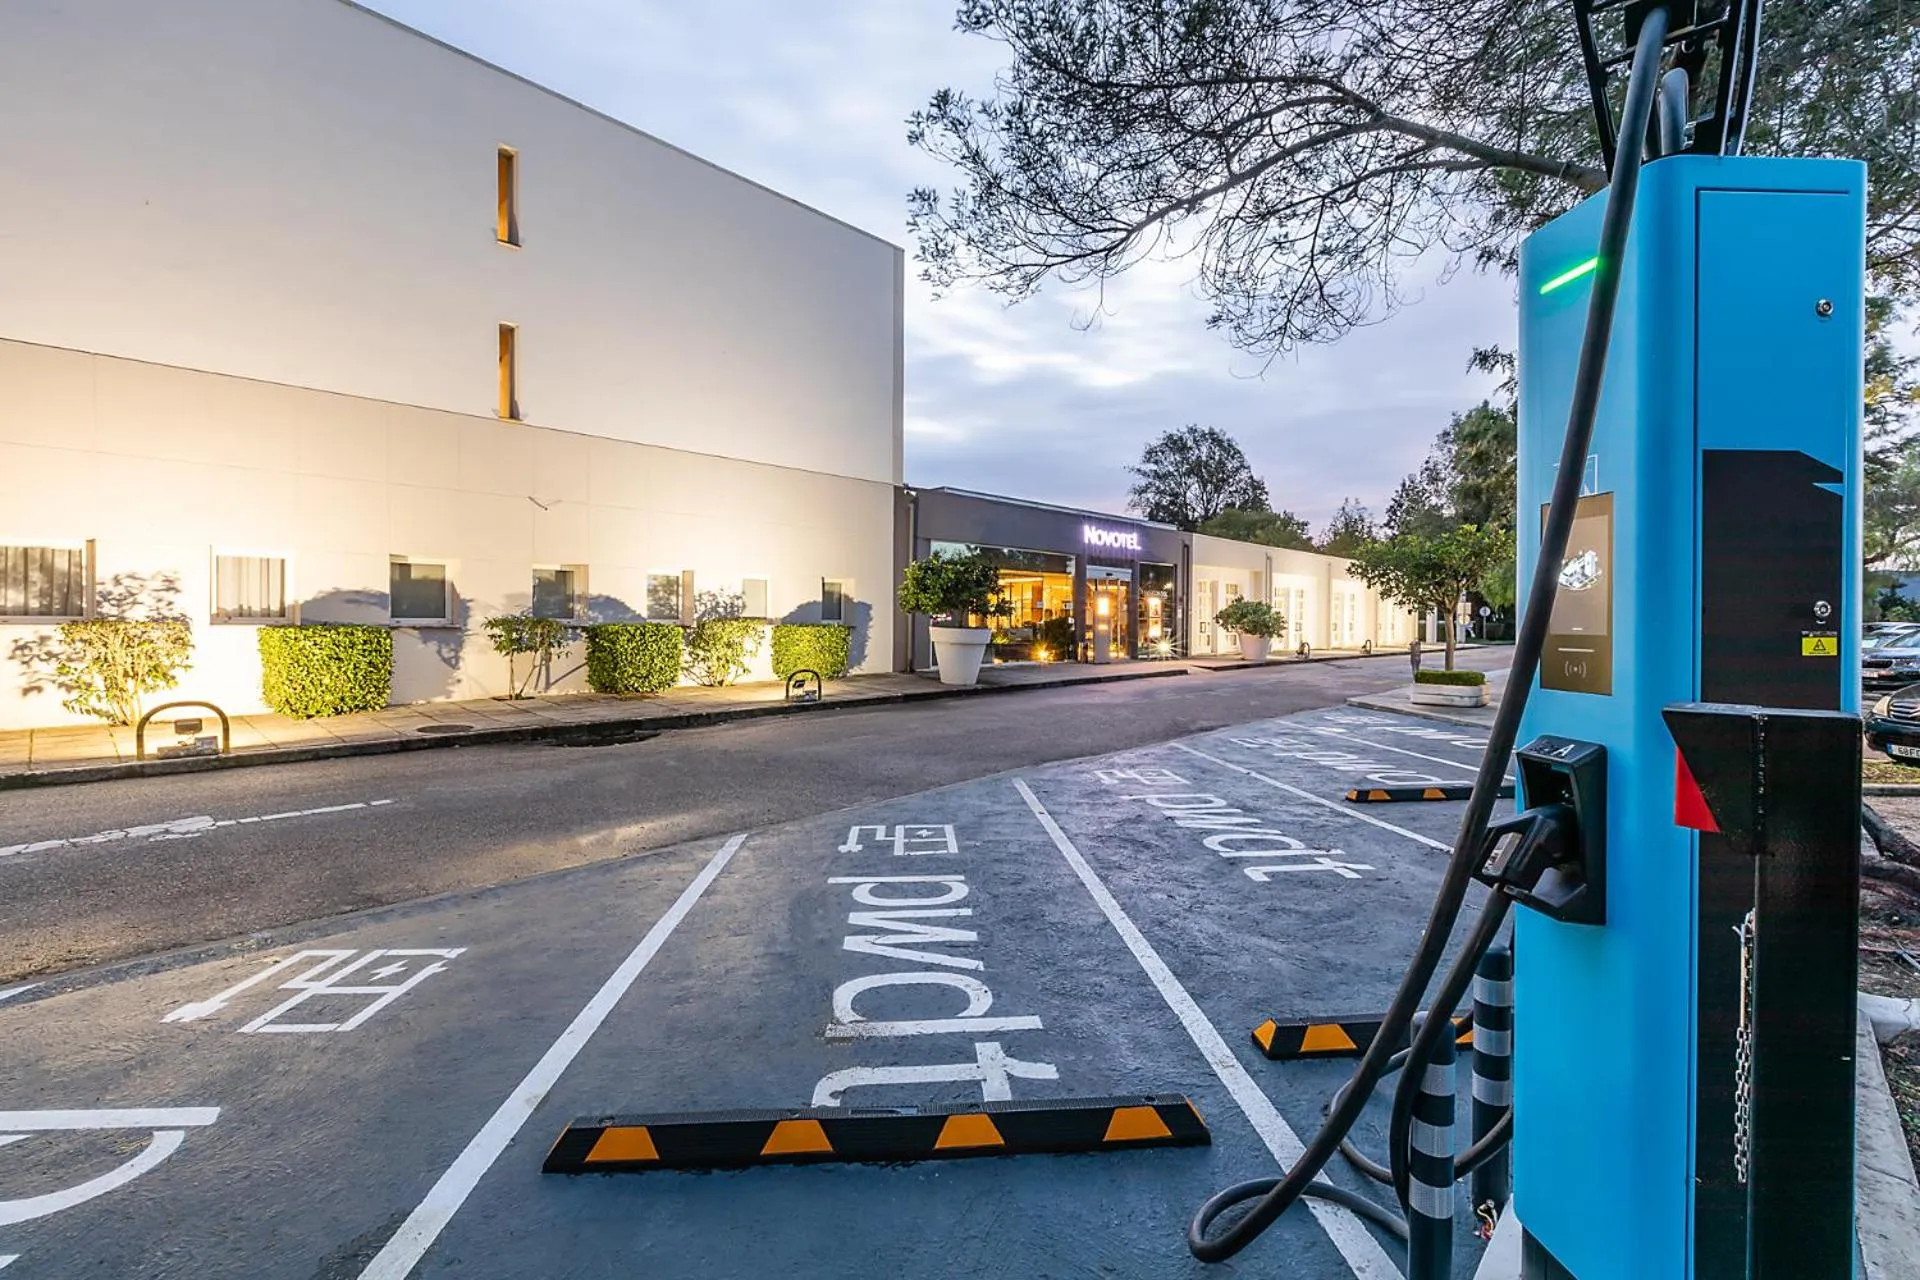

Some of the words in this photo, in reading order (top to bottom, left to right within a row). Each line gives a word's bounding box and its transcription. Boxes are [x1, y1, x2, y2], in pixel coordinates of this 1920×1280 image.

[1083, 524, 1142, 550] NOVOTEL
[1273, 752, 1473, 785] pwd
[810, 874, 1060, 1108] pwdt
